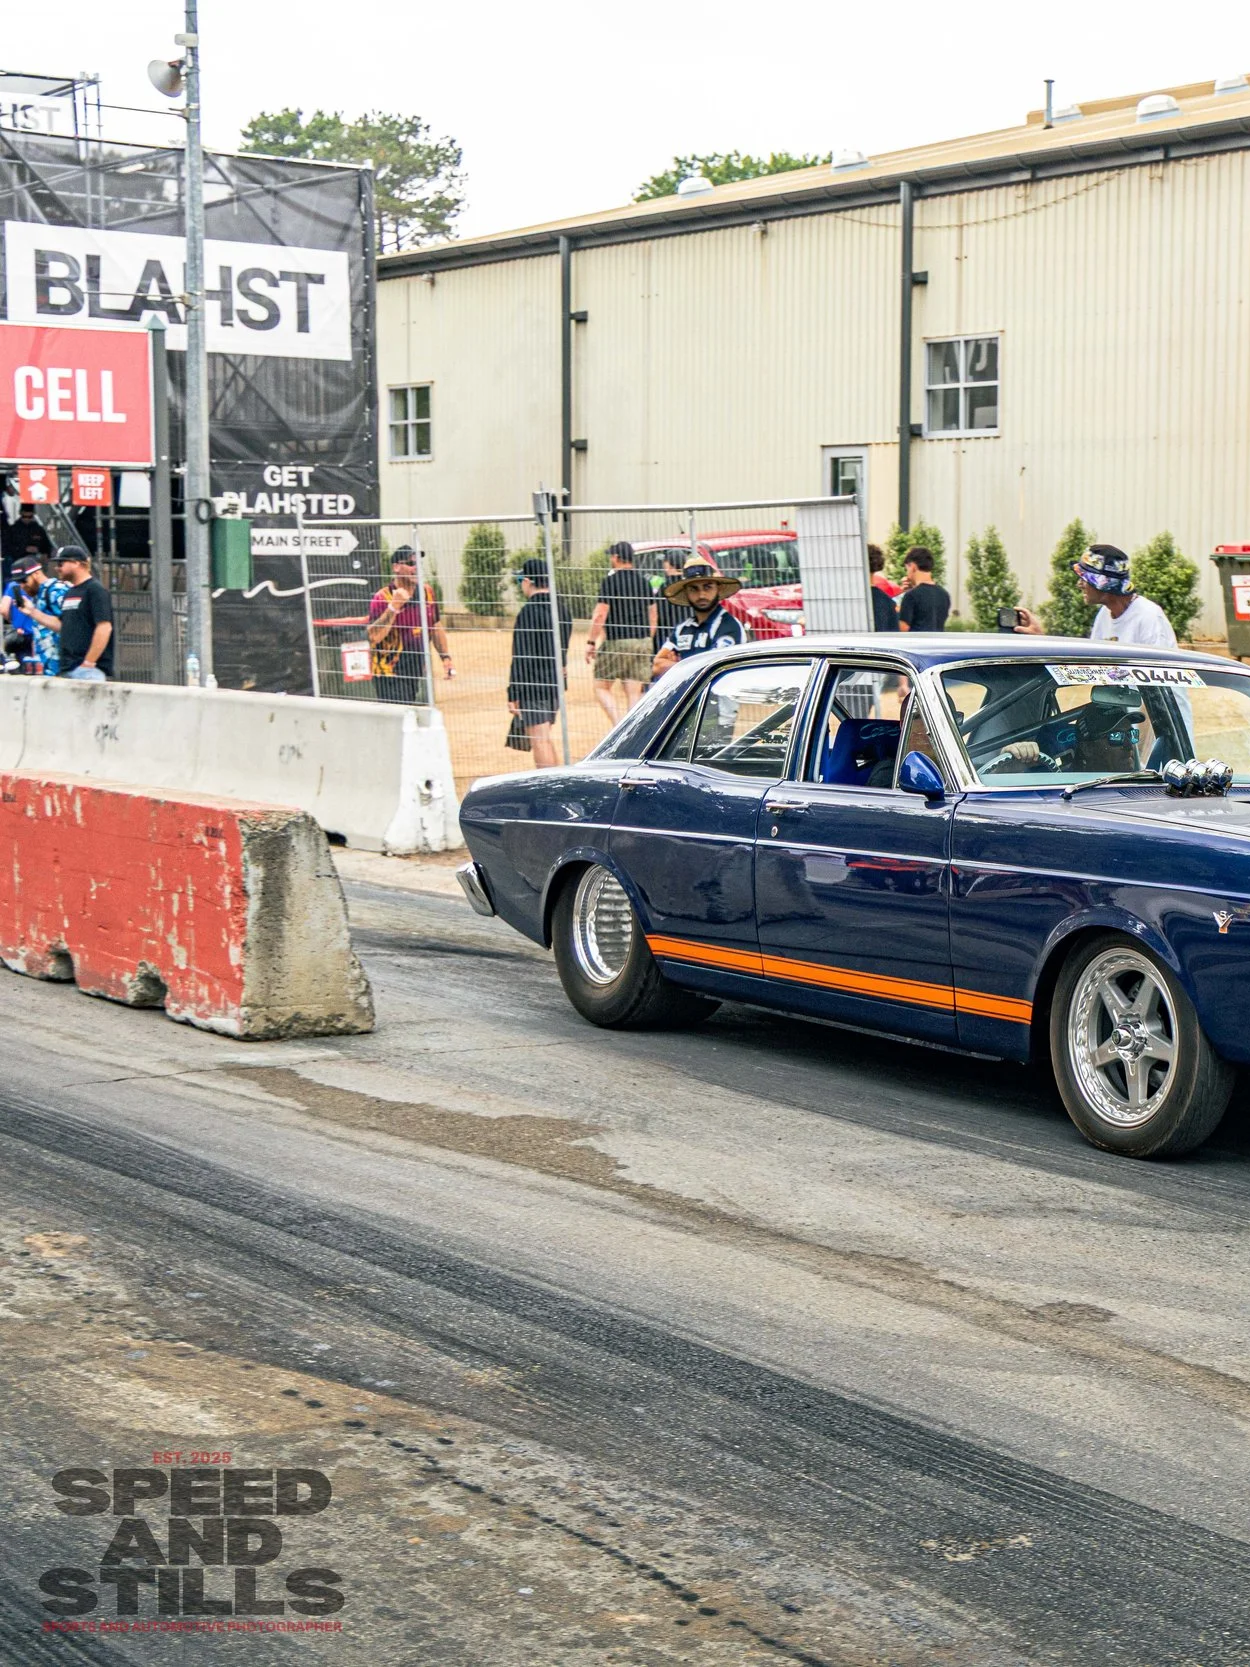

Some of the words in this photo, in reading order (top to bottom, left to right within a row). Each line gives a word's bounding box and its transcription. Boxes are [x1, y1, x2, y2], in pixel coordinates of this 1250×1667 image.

[34, 248, 325, 333] BLAHST
[14, 366, 127, 424] CELL
[263, 465, 314, 487] GET
[251, 536, 288, 547] MAIN
[292, 536, 343, 548] STREET
[1131, 669, 1192, 685] 0444
